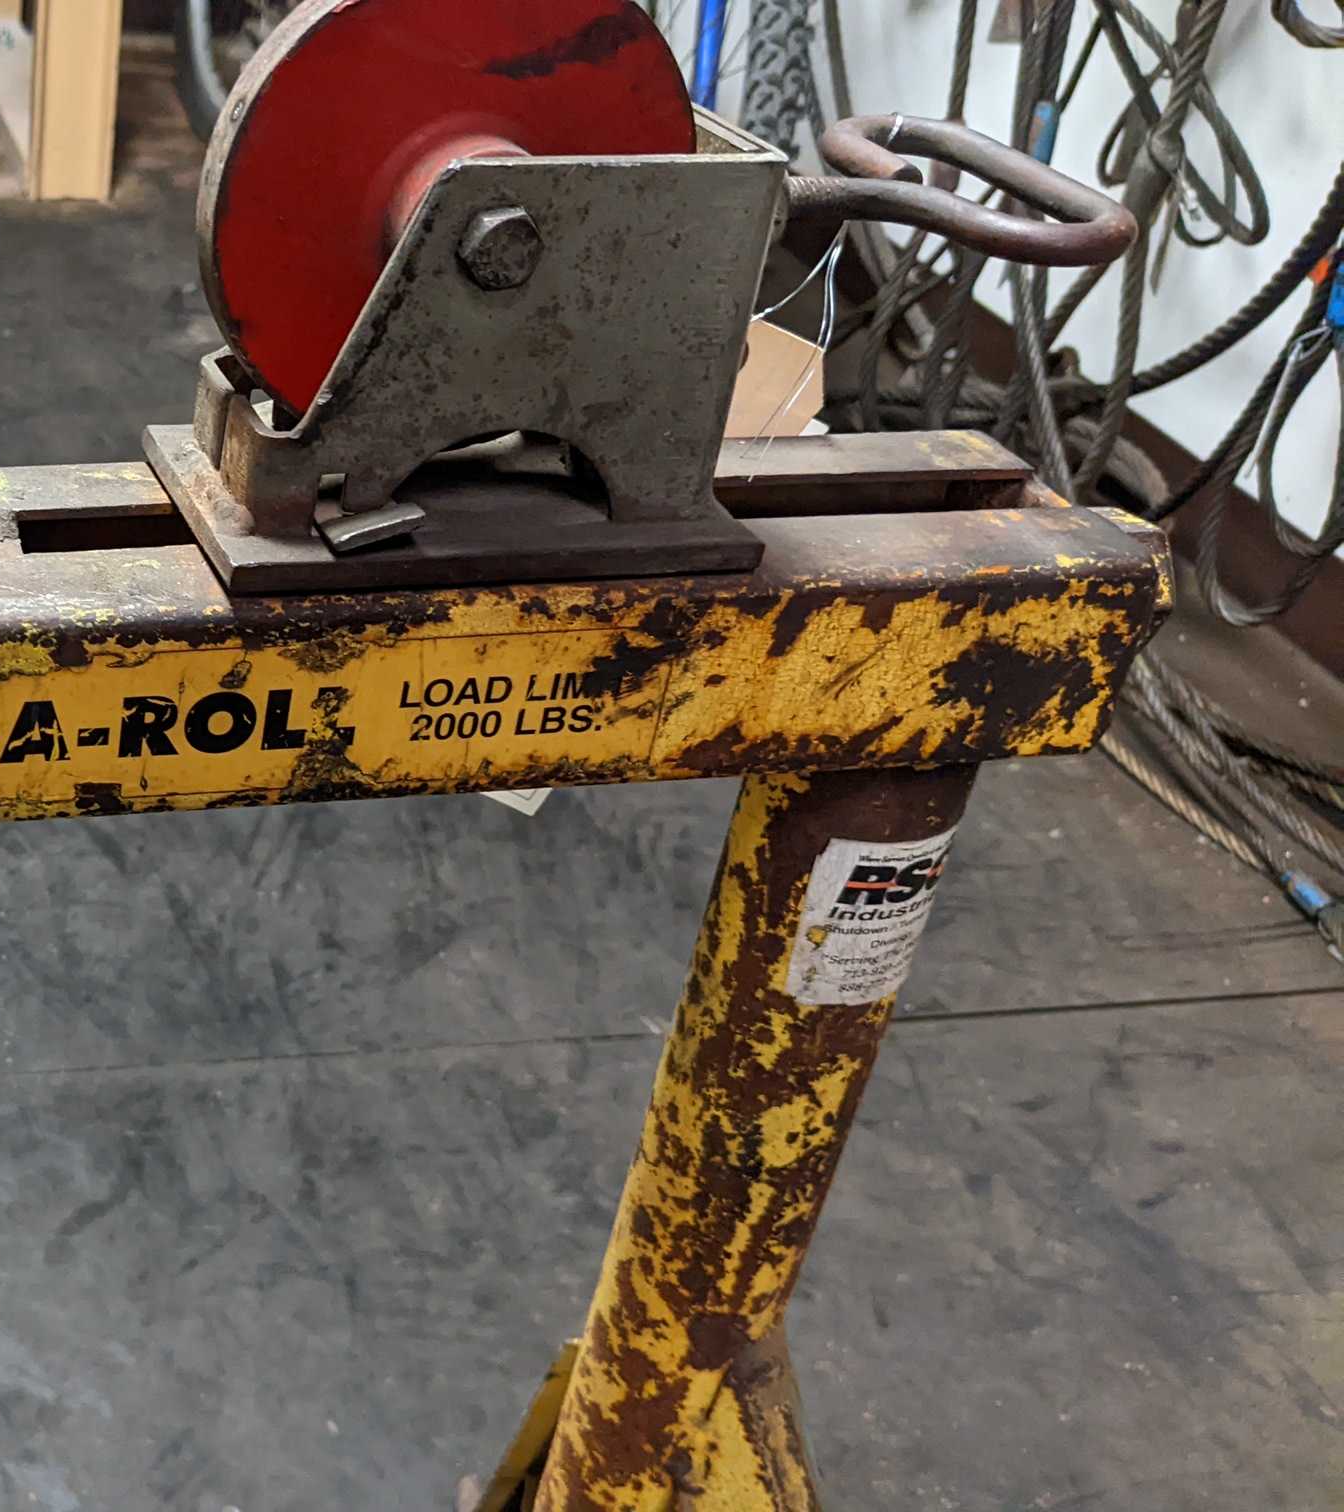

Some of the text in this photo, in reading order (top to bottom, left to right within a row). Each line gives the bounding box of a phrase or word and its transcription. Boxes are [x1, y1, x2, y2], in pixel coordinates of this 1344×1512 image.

[399, 670, 627, 709] LOAD LIM
[409, 704, 603, 742] 2000 LBS.
[824, 923, 889, 936] Shutdown
